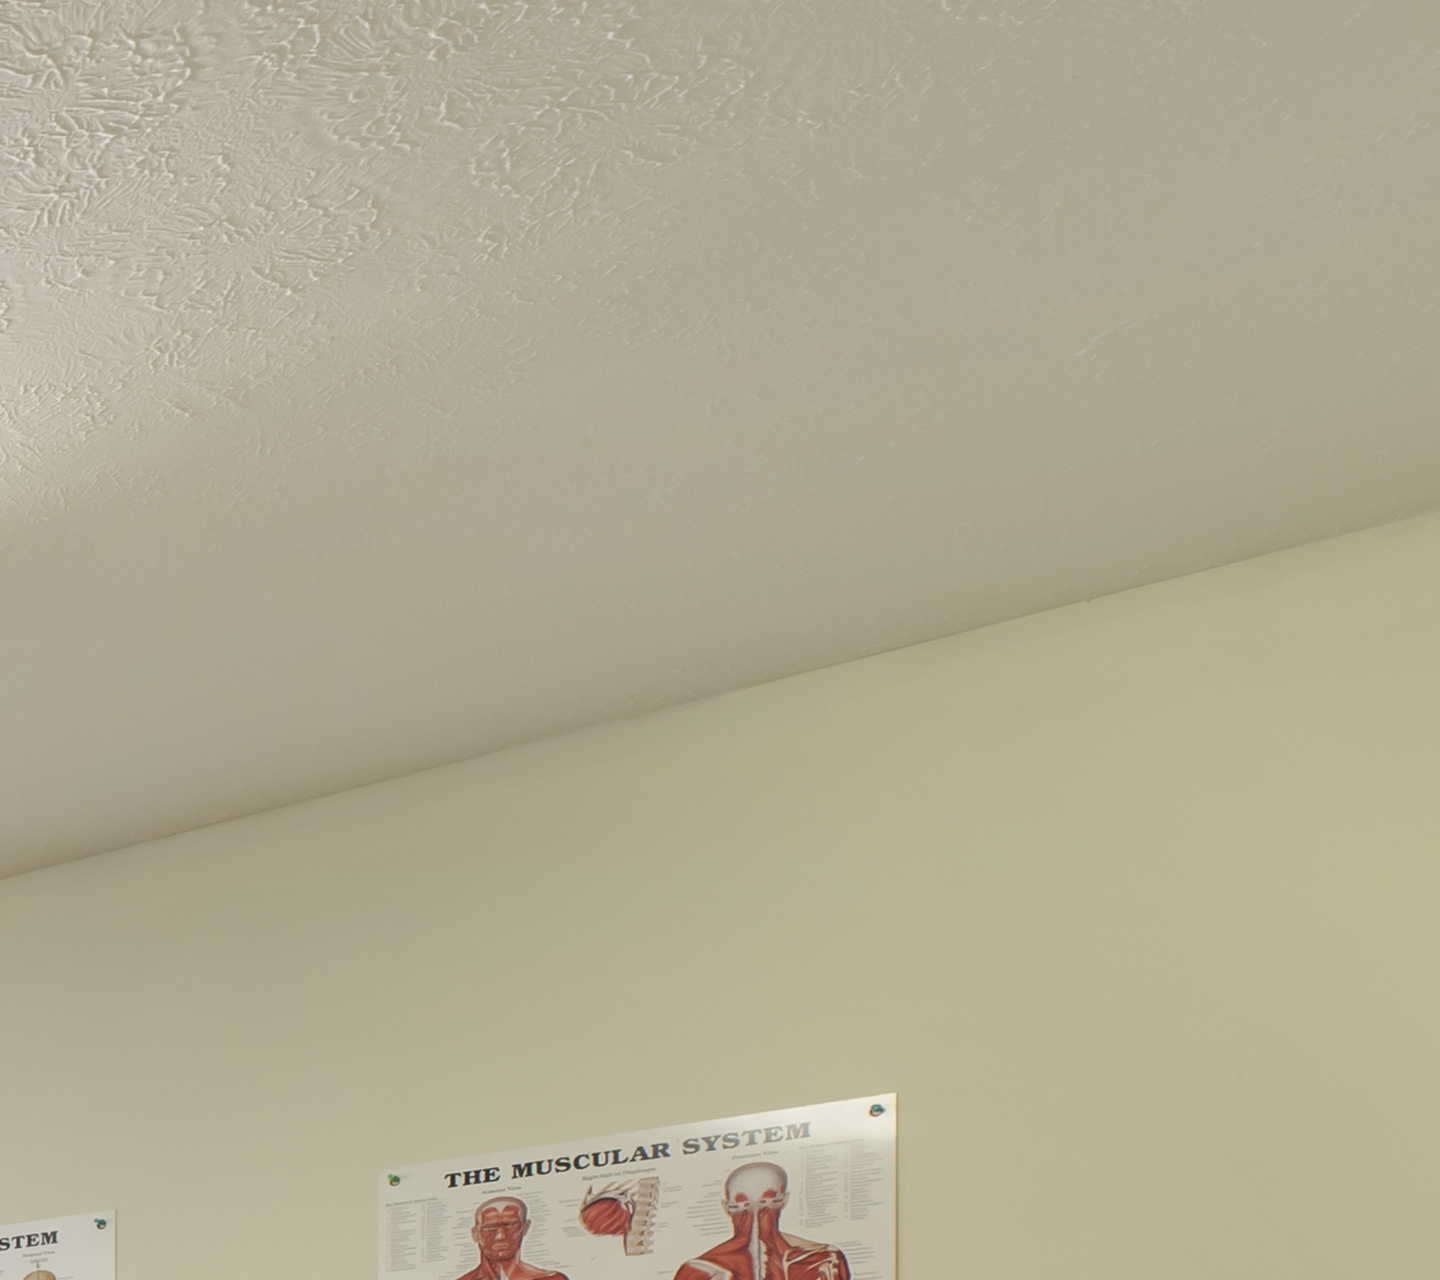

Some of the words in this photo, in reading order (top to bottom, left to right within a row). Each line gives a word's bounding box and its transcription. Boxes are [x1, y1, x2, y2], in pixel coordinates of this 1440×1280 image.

[443, 1166, 501, 1188] THE
[511, 1142, 671, 1180] MUSCULAR
[682, 1121, 812, 1155] SYSTEM
